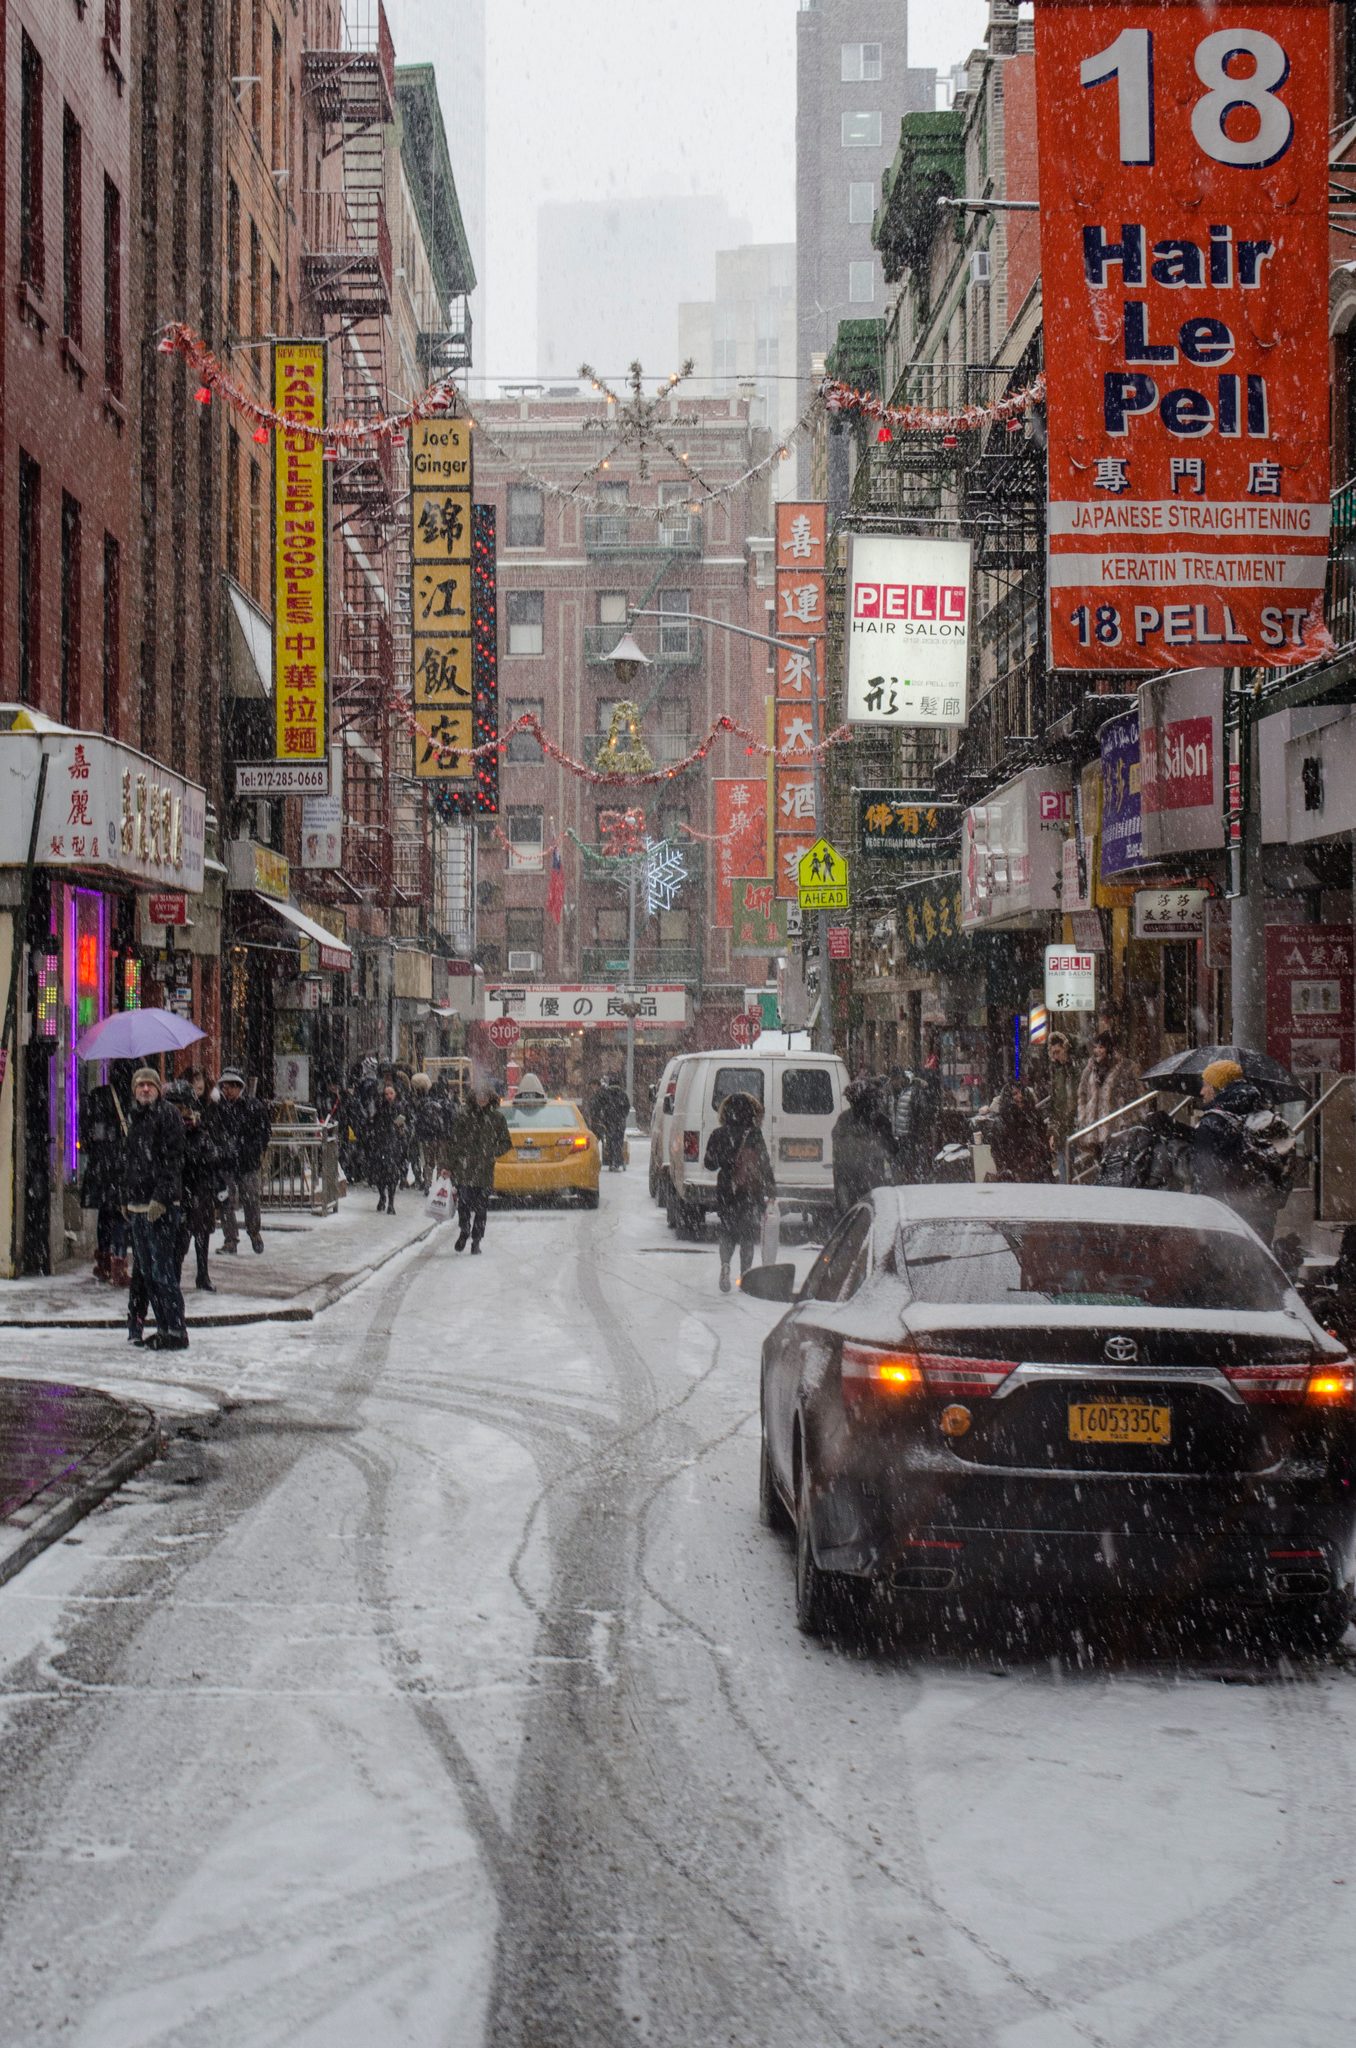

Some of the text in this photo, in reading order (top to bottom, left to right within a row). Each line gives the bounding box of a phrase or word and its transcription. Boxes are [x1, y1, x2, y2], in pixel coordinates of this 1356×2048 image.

[1080, 28, 1294, 169] 18
[1083, 224, 1275, 288] Hair
[1124, 301, 1235, 366] Le
[1104, 373, 1269, 438] Pell
[415, 453, 467, 476] Ginger
[1093, 456, 1283, 494] 專門店
[1072, 505, 1311, 530] JAPANESE STRAIGHTENING
[283, 520, 316, 624] NOODLES
[1102, 558, 1286, 582] KERATIN TREATMENT
[856, 585, 963, 619] PELL
[417, 498, 470, 769] 錦江飯店
[853, 622, 965, 637] HAIR SALON
[1070, 605, 1308, 648] 18 PELL ST
[284, 632, 317, 754] 中華拉麵
[1163, 734, 1207, 780] Salon
[66, 744, 93, 825] 嘉麗
[257, 771, 324, 787] 212-285-0668
[865, 837, 903, 848] VEGETARIAN
[804, 891, 843, 905] AHEAD
[1144, 909, 1202, 920] 美容中心
[1049, 957, 1091, 970] PELL
[540, 996, 657, 1017] 優の良品
[491, 1026, 519, 1039] STOP
[1078, 1406, 1161, 1433] T605335C
